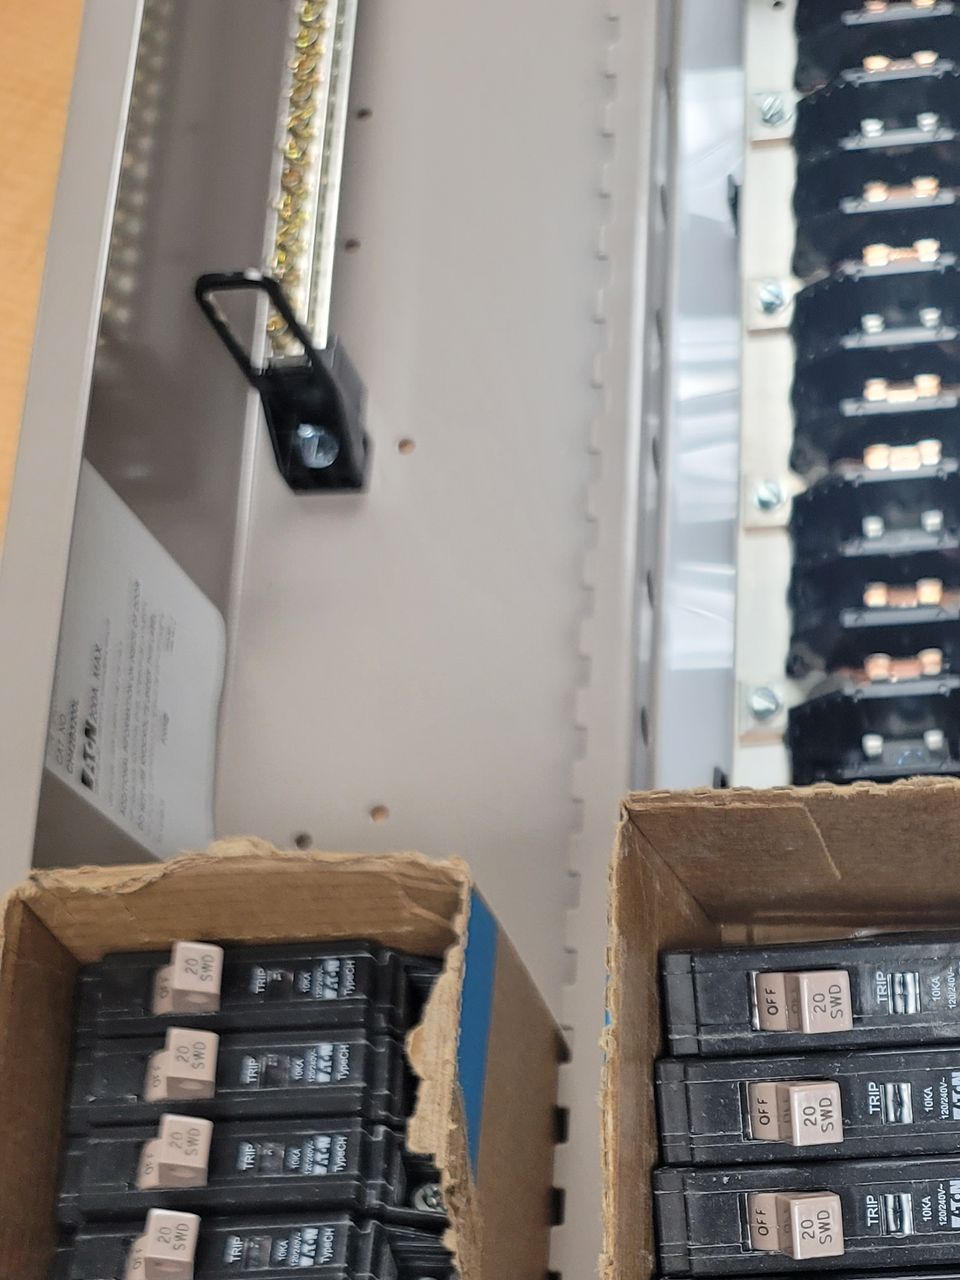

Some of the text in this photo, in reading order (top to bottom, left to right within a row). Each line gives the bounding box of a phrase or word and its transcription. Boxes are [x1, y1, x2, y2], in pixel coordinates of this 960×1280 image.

[92, 643, 103, 680] MAX
[185, 957, 198, 975] 20
[200, 954, 214, 982] SWD
[830, 983, 843, 1019] SWD
[876, 971, 888, 1005] TRIP
[932, 977, 941, 1001] 10KA
[765, 989, 778, 1016] OFF
[814, 992, 826, 1014] 20
[177, 1046, 189, 1064] 20
[192, 1041, 205, 1069] SWD
[758, 1098, 770, 1126] OFF
[868, 1082, 880, 1116] TRIP
[924, 1087, 933, 1112] 10KA
[803, 1105, 816, 1127] 20
[820, 1097, 835, 1132] SWD
[171, 1132, 184, 1150] 20
[186, 1128, 201, 1156] SWD
[756, 1208, 768, 1237] OFF
[867, 1195, 878, 1227] TRIP
[923, 1196, 932, 1222] 10KA
[160, 1227, 172, 1245] 20
[174, 1223, 189, 1251] SWD
[801, 1219, 815, 1240] 20
[819, 1210, 832, 1246] SWD
